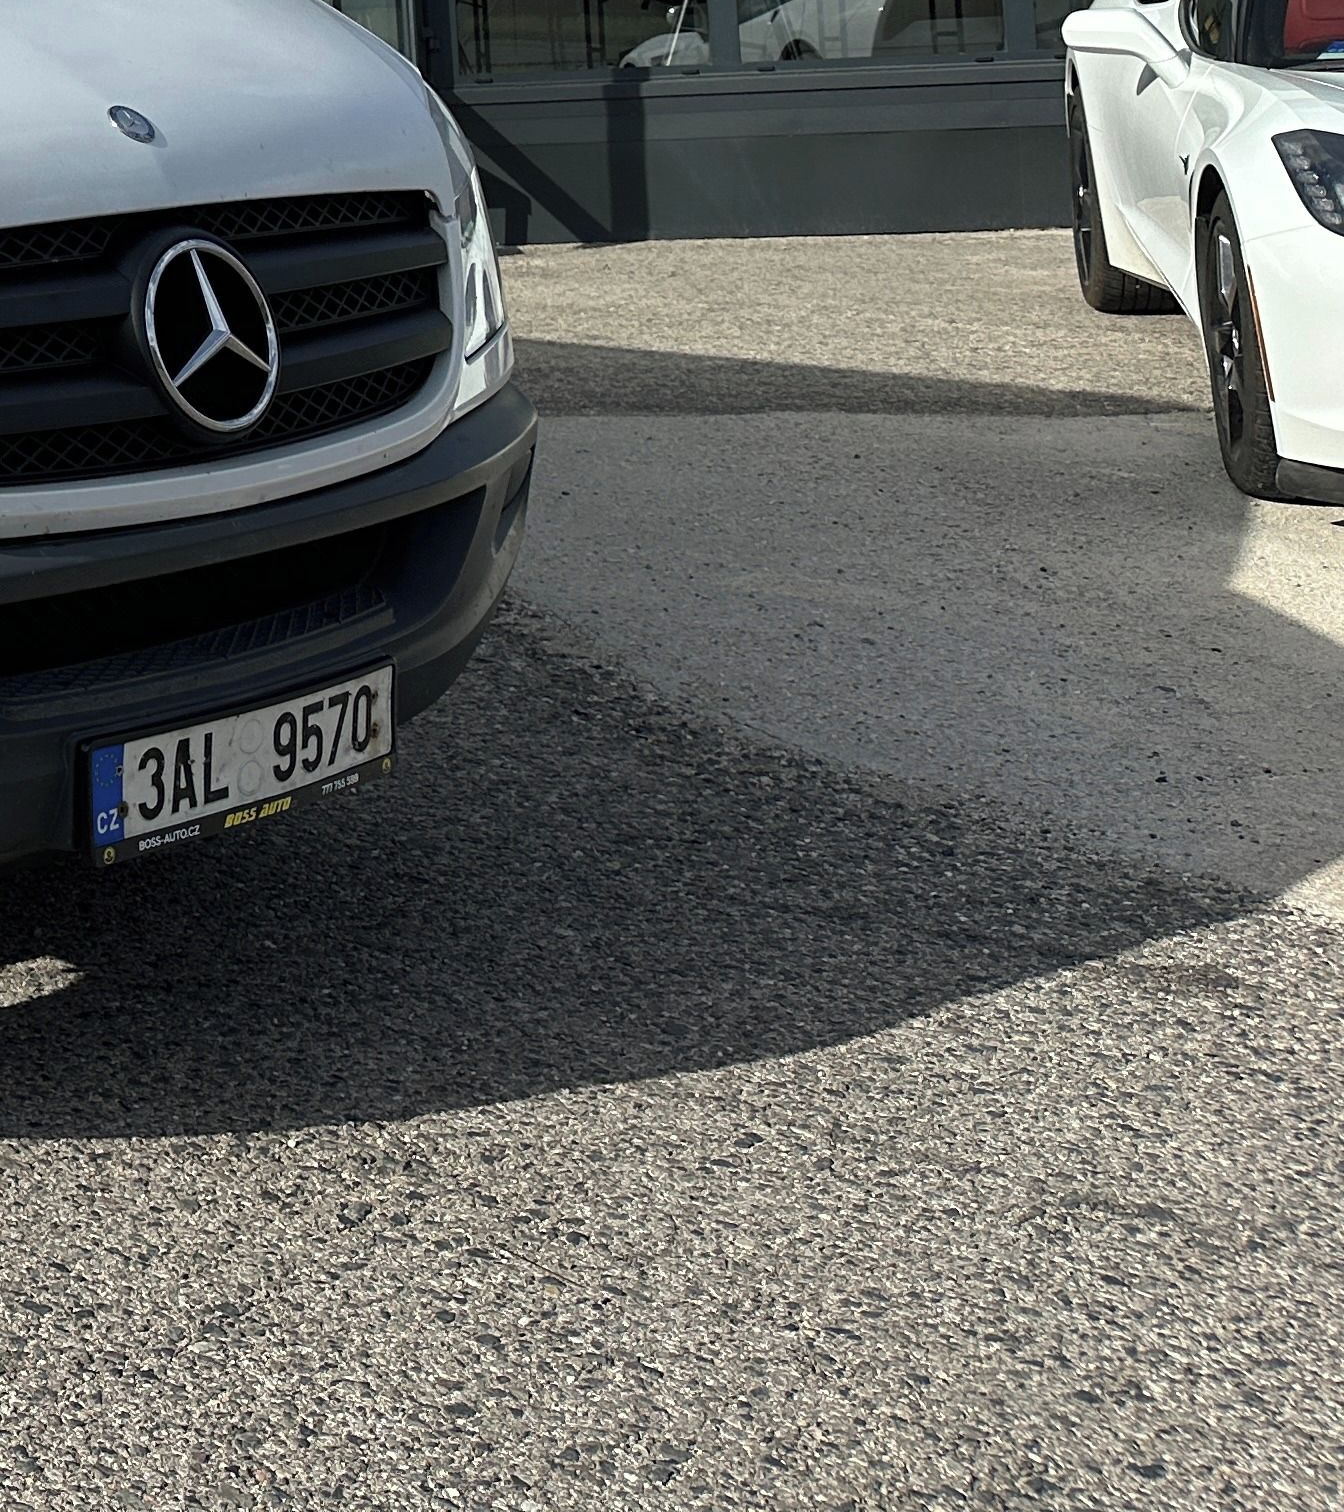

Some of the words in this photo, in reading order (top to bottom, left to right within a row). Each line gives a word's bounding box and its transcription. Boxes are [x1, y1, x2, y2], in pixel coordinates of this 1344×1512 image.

[137, 731, 230, 821] 3AL
[273, 685, 372, 782] 9570
[96, 808, 119, 834] CZ
[139, 825, 201, 851] BOSS-AUTO.CZ
[224, 807, 257, 829] BOSS
[260, 797, 292, 819] AUTO
